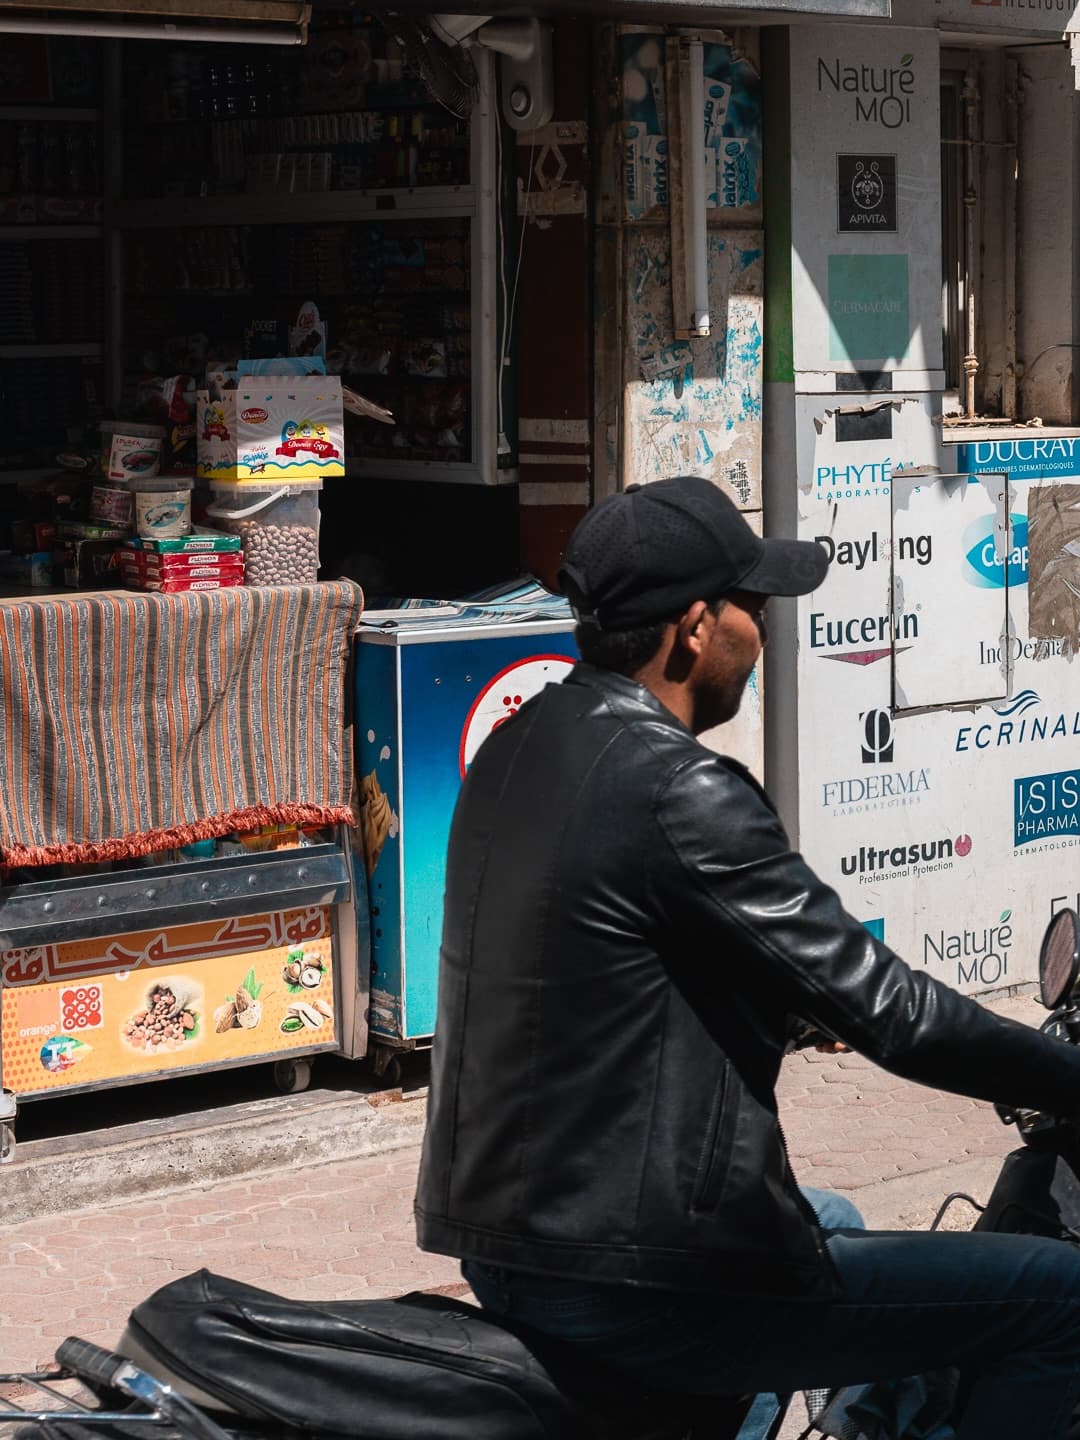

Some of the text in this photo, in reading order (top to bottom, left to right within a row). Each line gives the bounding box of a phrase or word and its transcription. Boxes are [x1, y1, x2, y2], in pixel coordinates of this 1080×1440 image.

[855, 95, 910, 129] MOI
[849, 214, 887, 224] APIVITA
[975, 440, 1077, 464] DUCRAY
[822, 768, 931, 808] FIDERMA
[1018, 775, 1079, 817] ISIS
[1017, 812, 1079, 837] PHARMA
[840, 838, 953, 876] ultrasun
[859, 861, 954, 885] Professional Protection
[957, 951, 1007, 985] MOI
[19, 1023, 57, 1038] orange
